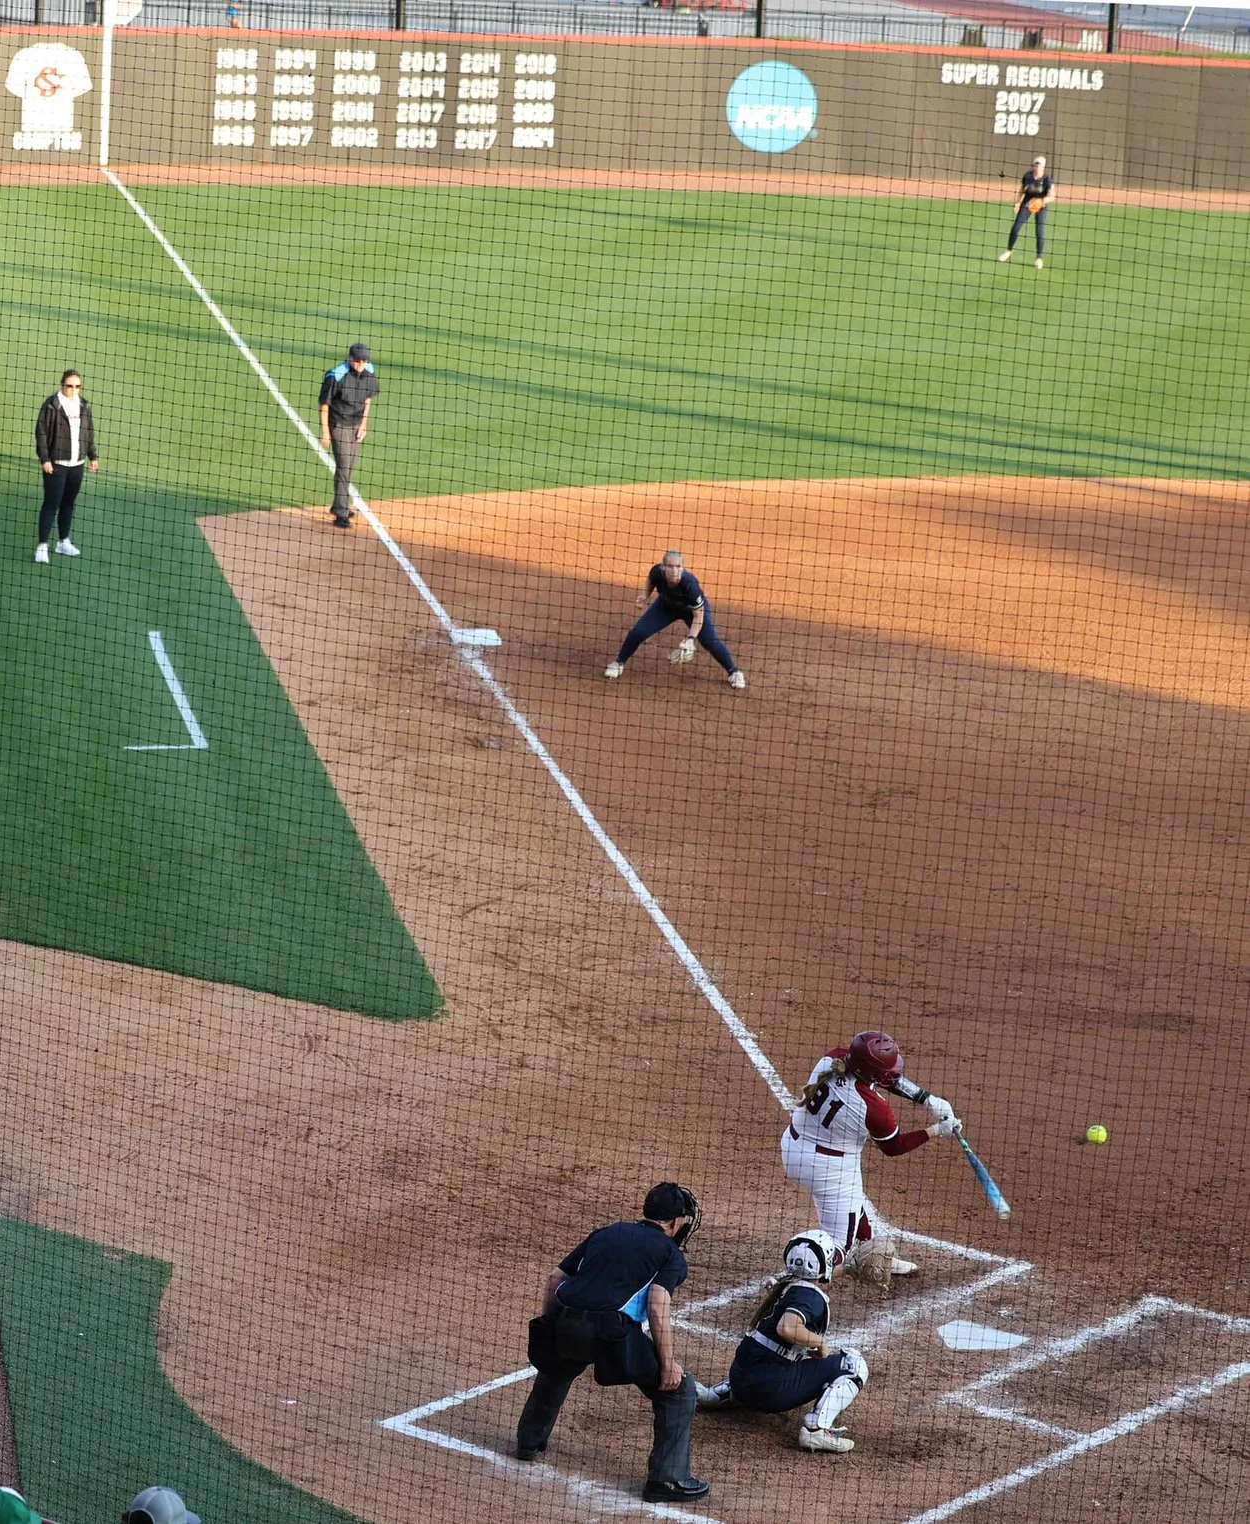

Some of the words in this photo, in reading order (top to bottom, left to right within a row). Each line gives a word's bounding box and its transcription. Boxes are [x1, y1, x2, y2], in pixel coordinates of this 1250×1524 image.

[274, 48, 317, 70] 1994
[399, 51, 447, 72] 2003
[460, 53, 501, 74] 2014
[273, 74, 316, 96] 1995
[332, 74, 381, 96] 2000
[397, 77, 445, 98] 2004
[458, 78, 500, 99] 2015
[941, 62, 1000, 86] SUPER
[1005, 65, 1104, 91] REGIONALS
[331, 100, 374, 122] 2001
[396, 102, 445, 124] 2007
[995, 91, 1046, 113] 2007
[735, 104, 813, 130] NCAA
[269, 125, 314, 147] 1997
[330, 126, 379, 148] 2002
[395, 128, 438, 149] 2013
[454, 129, 498, 150] 2017
